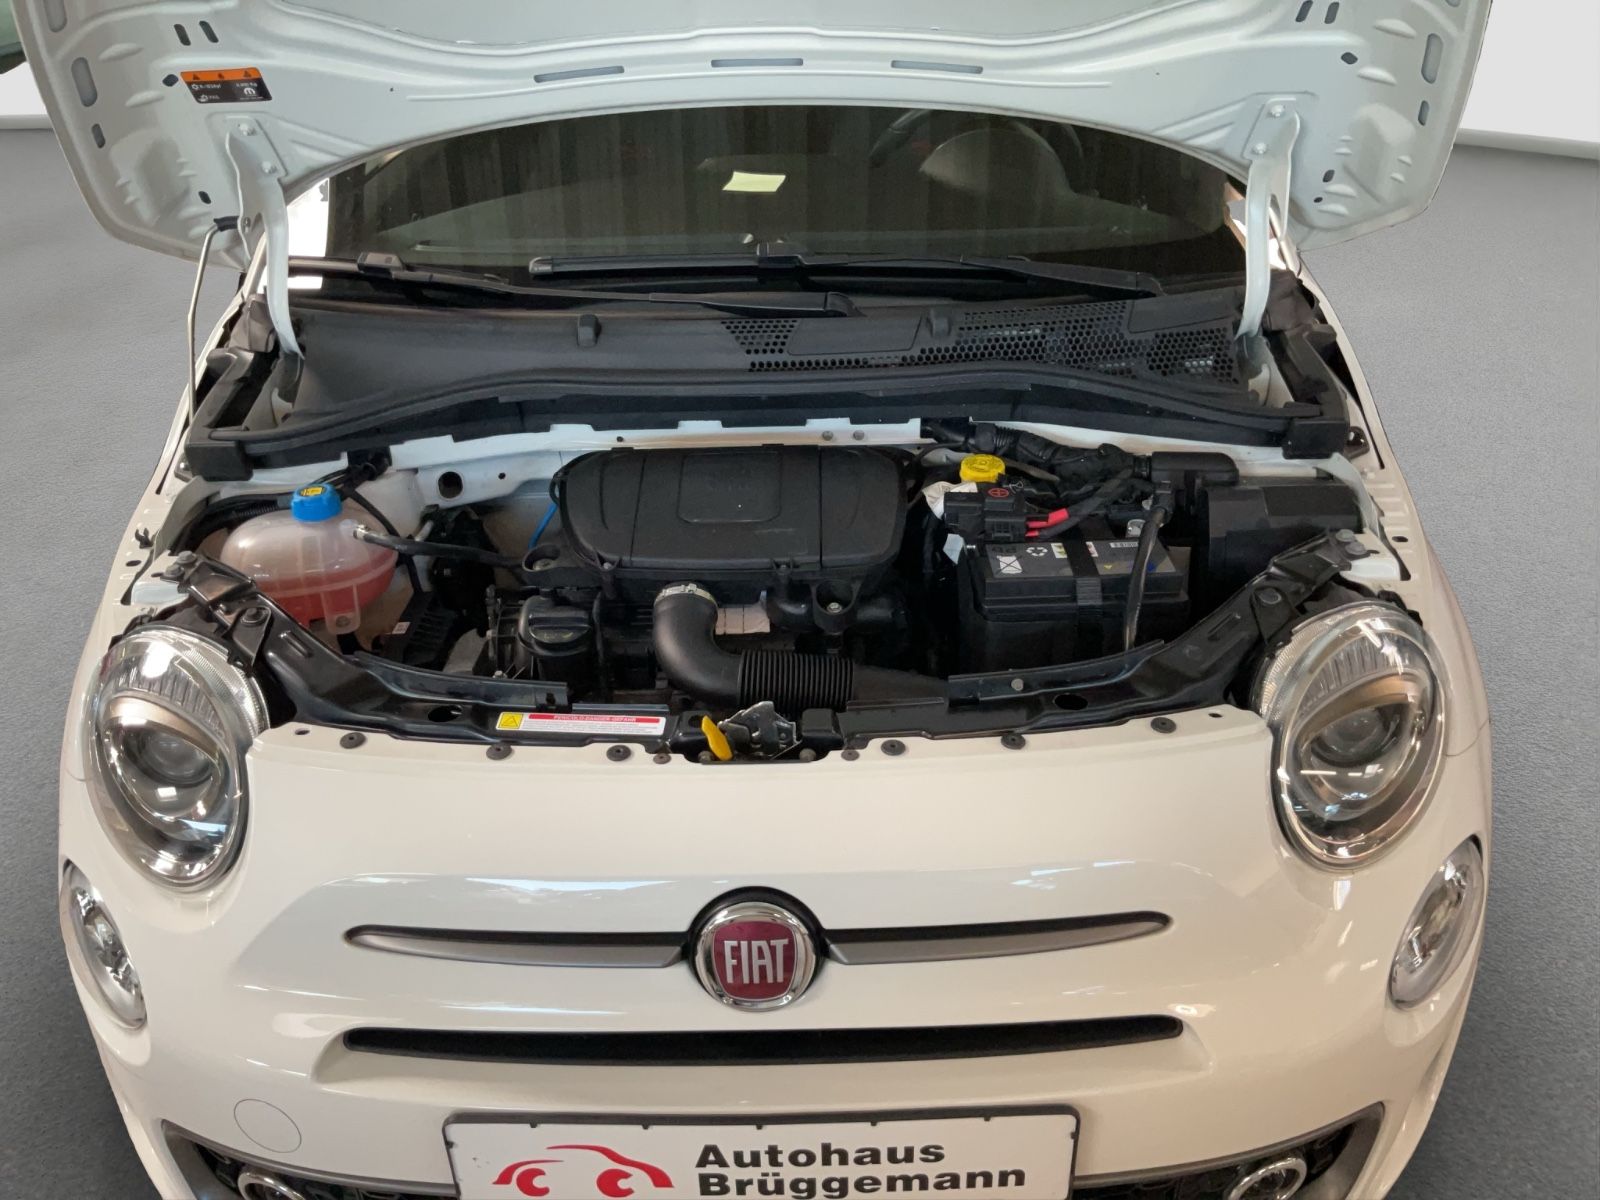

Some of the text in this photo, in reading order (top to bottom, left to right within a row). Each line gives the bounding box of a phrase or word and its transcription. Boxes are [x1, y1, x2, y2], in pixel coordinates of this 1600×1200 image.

[723, 938, 788, 984] FIAT
[695, 1142, 945, 1168] Autohaus
[698, 1168, 1026, 1200] Brüggemann
